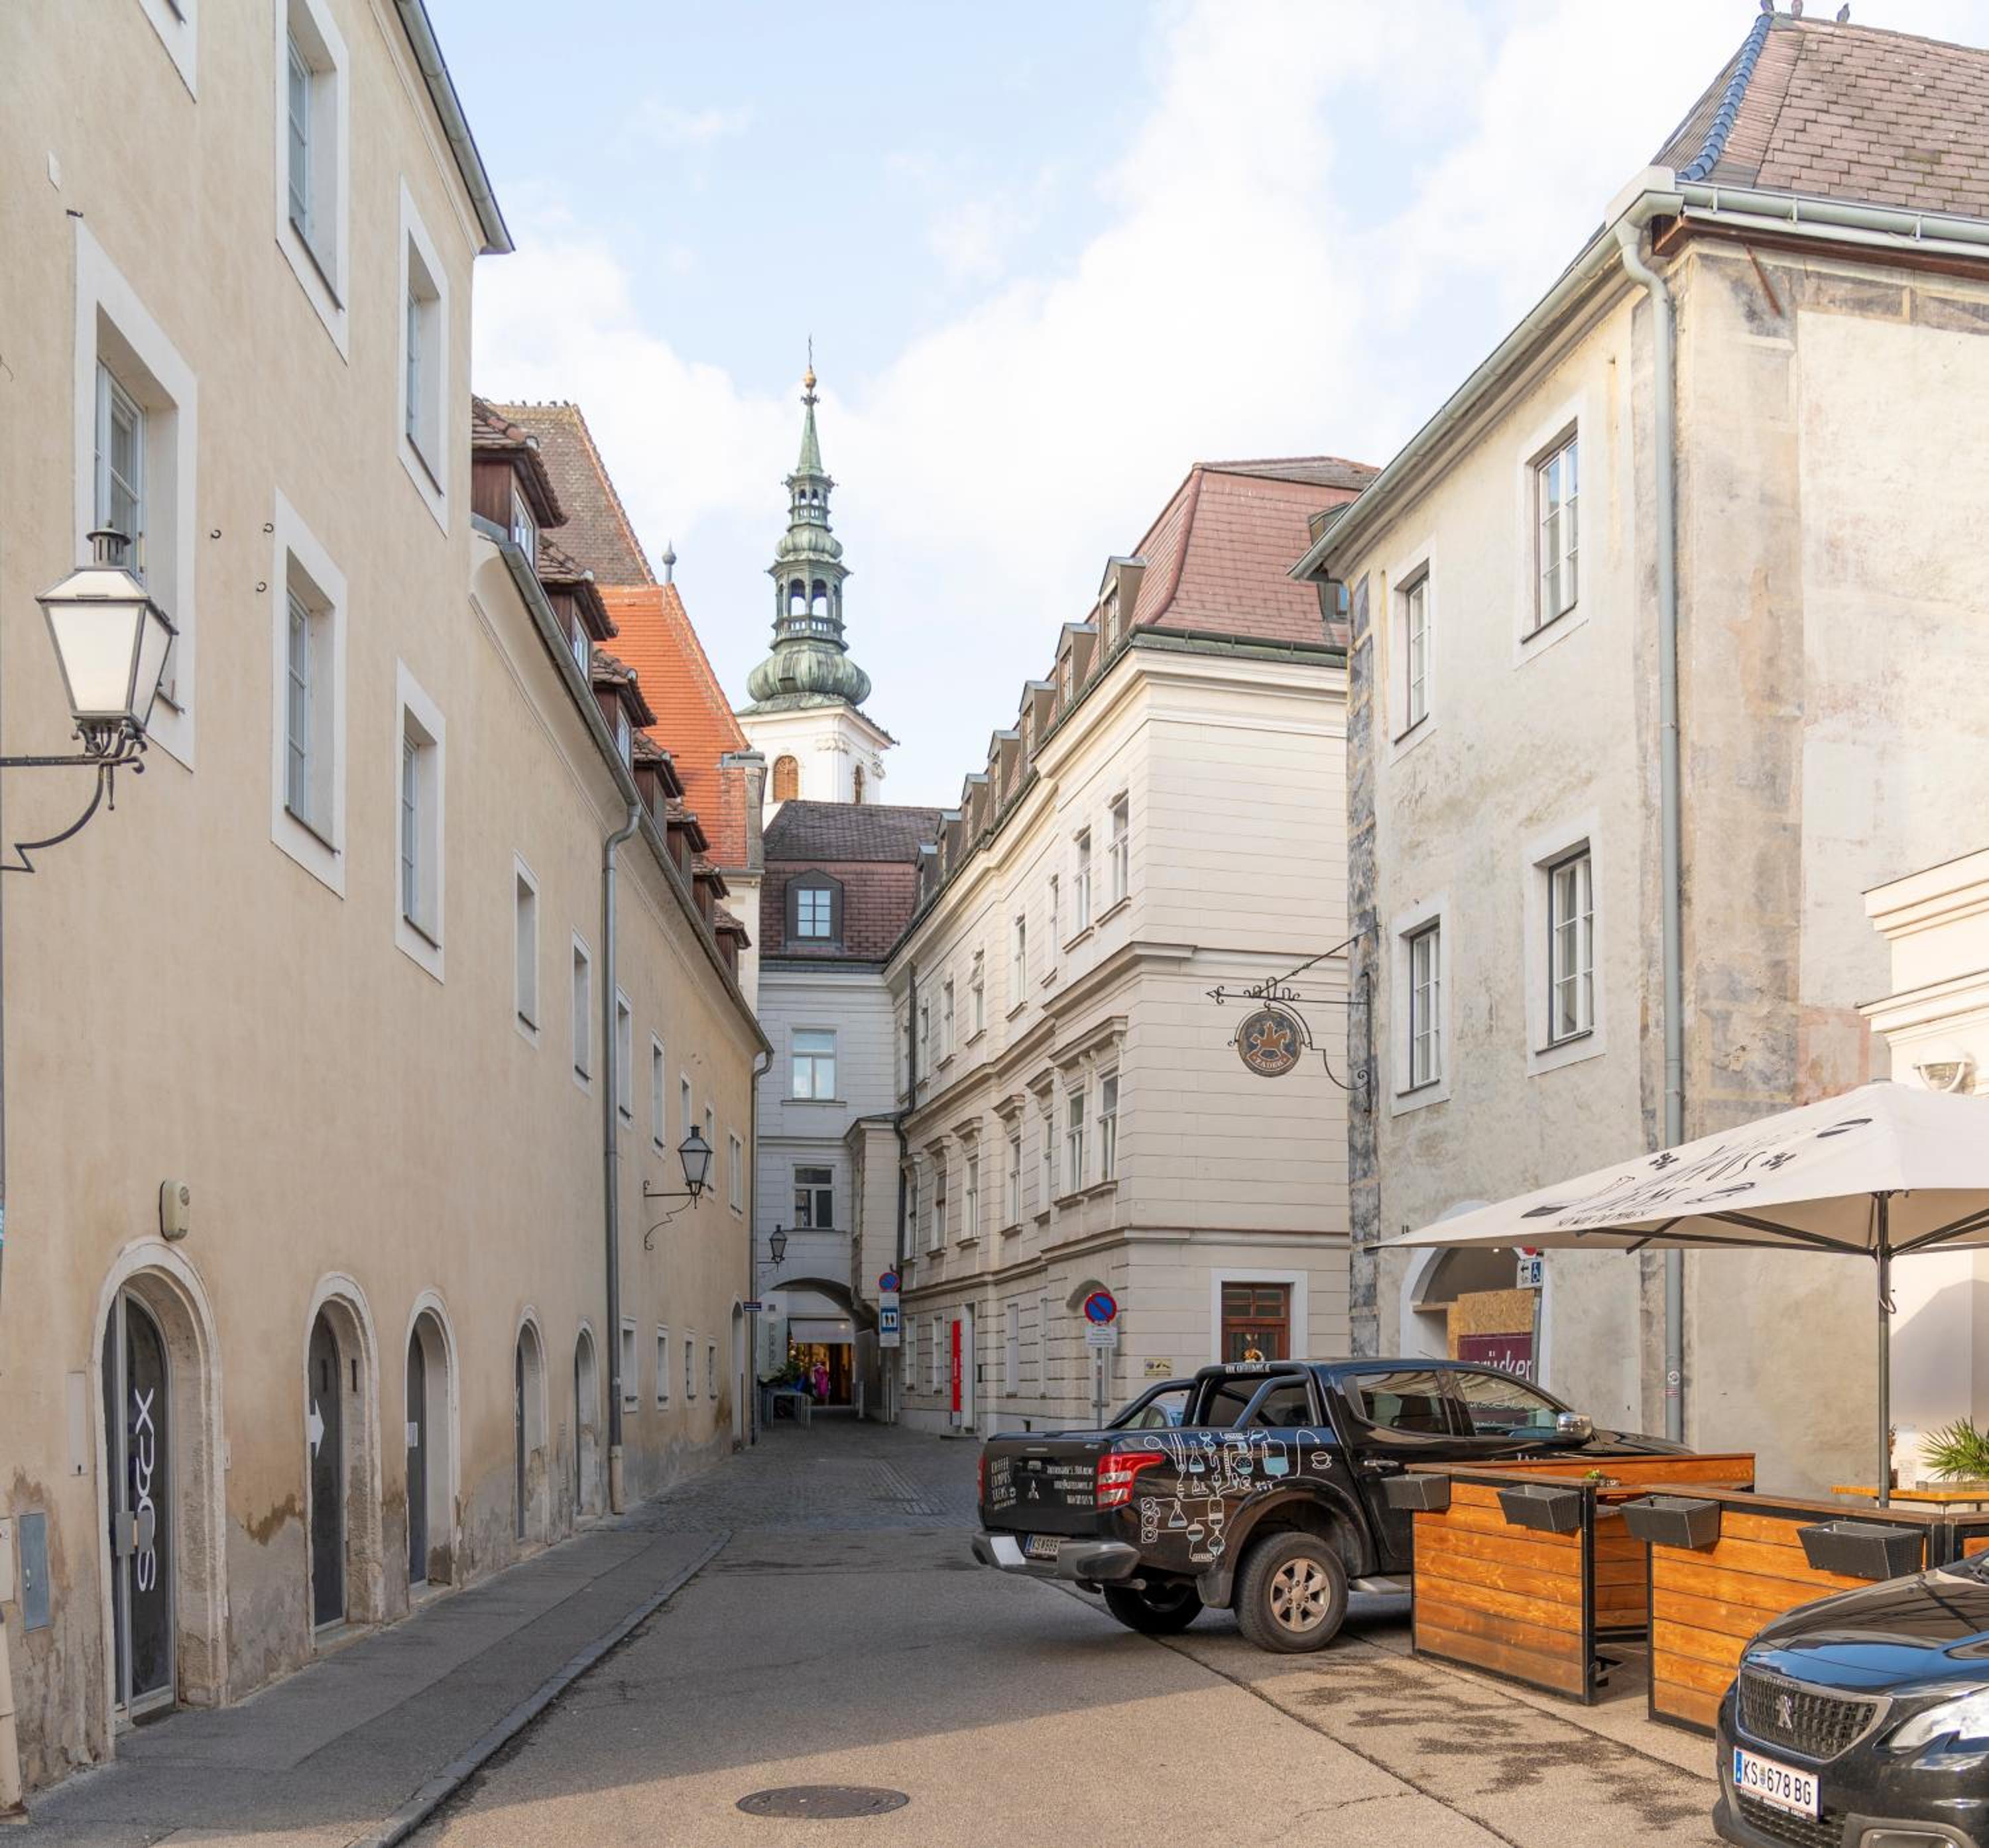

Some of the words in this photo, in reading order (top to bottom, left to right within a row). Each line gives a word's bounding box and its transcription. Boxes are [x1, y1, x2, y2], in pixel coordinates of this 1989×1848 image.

[1744, 1761, 1758, 1785] KS
[1767, 1768, 1790, 1798] 678
[1795, 1777, 1811, 1805] BG
